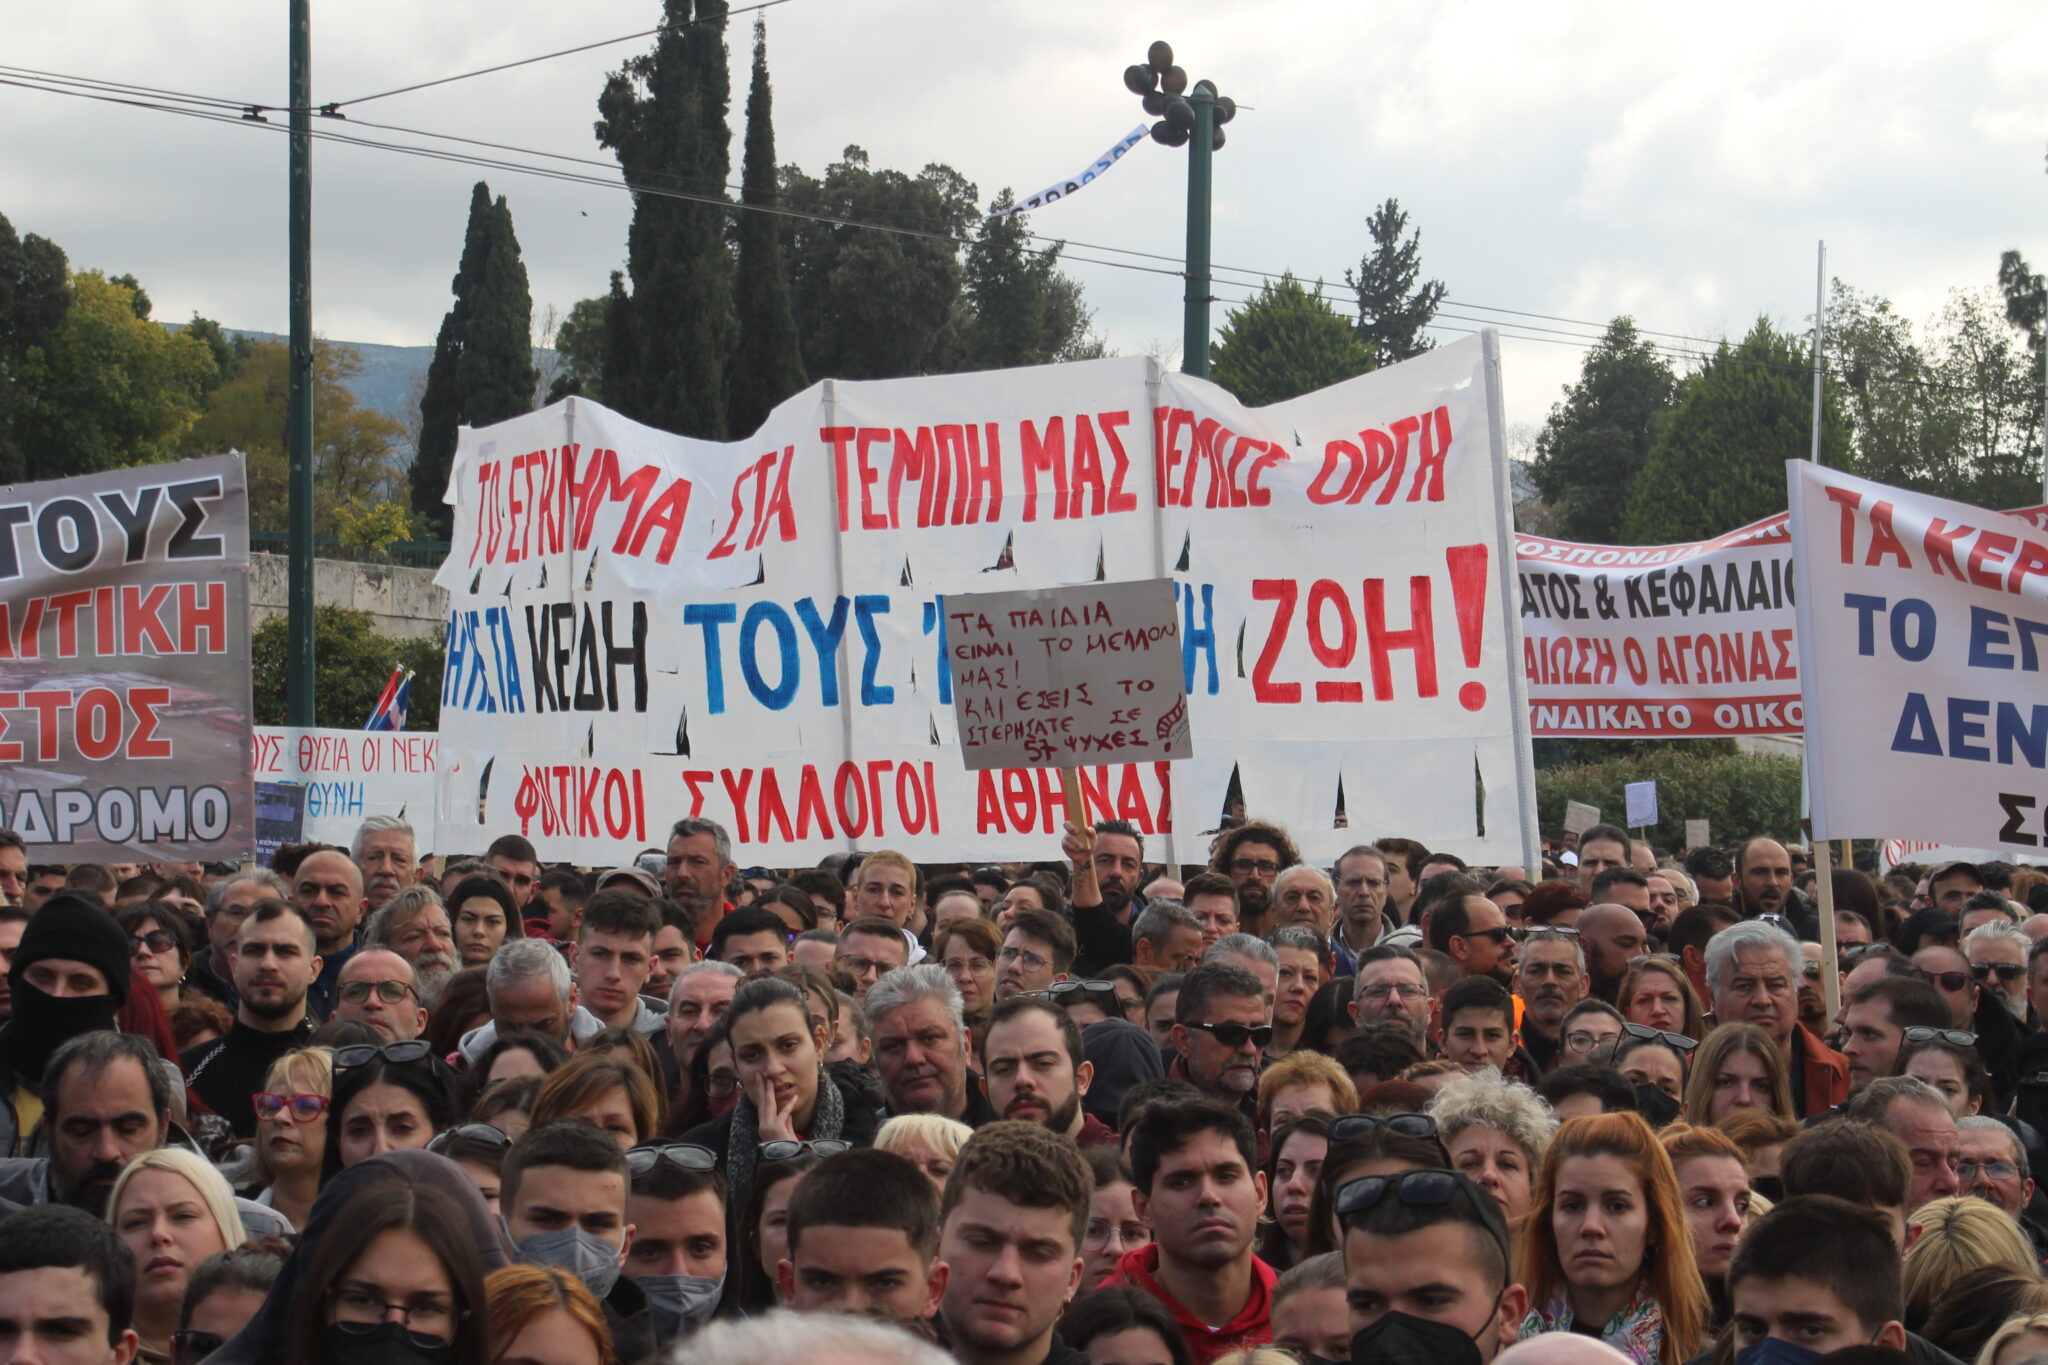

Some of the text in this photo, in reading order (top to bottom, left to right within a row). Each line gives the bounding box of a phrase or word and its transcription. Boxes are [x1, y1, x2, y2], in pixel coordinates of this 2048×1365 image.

[706, 445, 798, 560] ΣΤΑ
[820, 422, 1001, 532] ΤΕΜΠΗ
[1019, 410, 1137, 522] ΜΑΣ
[1306, 405, 1452, 505] ΟΡΓΗ
[1515, 540, 1706, 567] ΟΣΠΟΝΔΙΑ
[1825, 485, 1912, 569] ΤΑ
[951, 600, 1113, 638] ΤΑ ΠΑΙΔΙΑ
[1593, 573, 1619, 620] &
[684, 594, 895, 715] ΤΟΥΣ
[1252, 543, 1489, 712] ΖΩΗ!
[1039, 637, 1073, 658] ΤΟ
[1844, 592, 1937, 663] ΤΟ
[1623, 636, 1648, 686] Ο
[1657, 628, 1797, 685] ΑΓΩΝΑΣ
[964, 697, 1004, 723] ΚΑΙ
[1116, 680, 1154, 695] ΤΟ
[1890, 691, 2048, 769] ΔΕΝ
[299, 734, 350, 773] ΘΥΣΙΑ
[362, 737, 381, 773] ΟΙ
[393, 737, 439, 774] ΝΕΚ
[1024, 737, 1058, 762] 57
[0, 785, 230, 847] ΔΡΟΜΟ
[682, 760, 940, 844] ΣΥΛΛΟΓΟΙ
[1997, 792, 2048, 849] Σ
